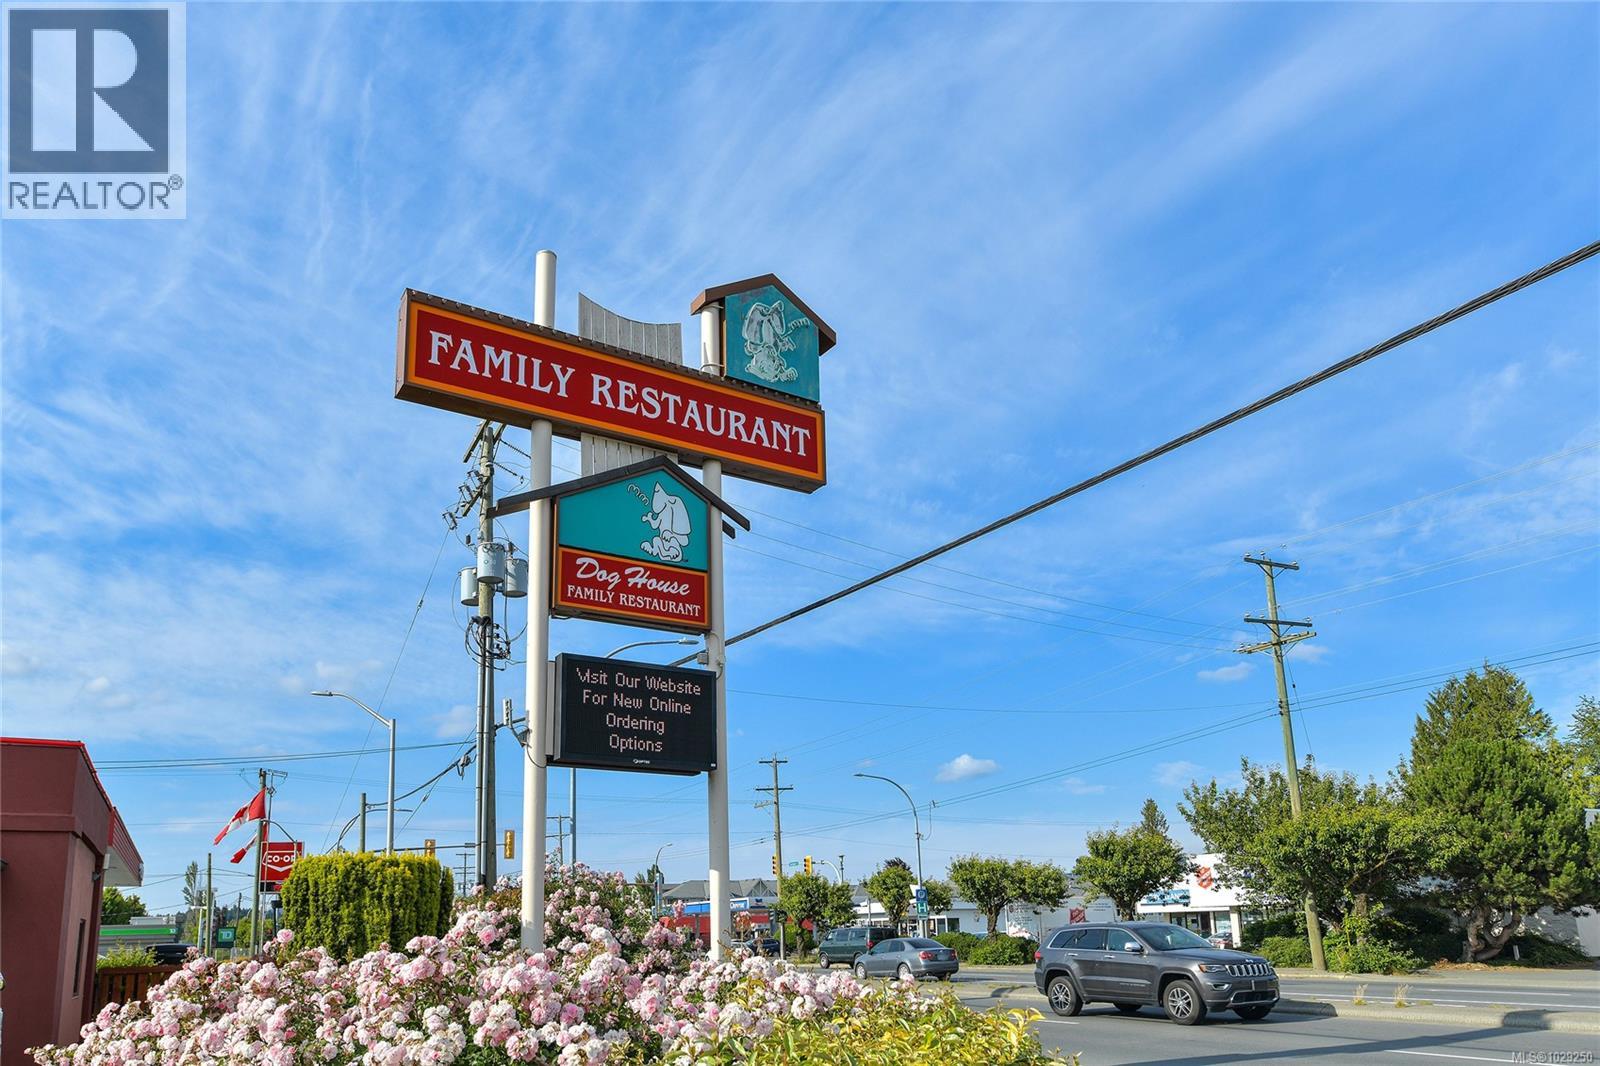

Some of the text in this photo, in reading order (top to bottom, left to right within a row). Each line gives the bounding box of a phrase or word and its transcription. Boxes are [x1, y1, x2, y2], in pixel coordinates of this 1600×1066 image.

[428, 329, 811, 457] FAMILY RESTAURANT
[576, 557, 690, 596] Dog House
[567, 584, 701, 617] FAMILY RESTAURANT
[576, 667, 701, 696] Visit Our Website
[583, 689, 691, 715] For New Online
[606, 713, 665, 735] Ordering
[609, 734, 663, 753] Options
